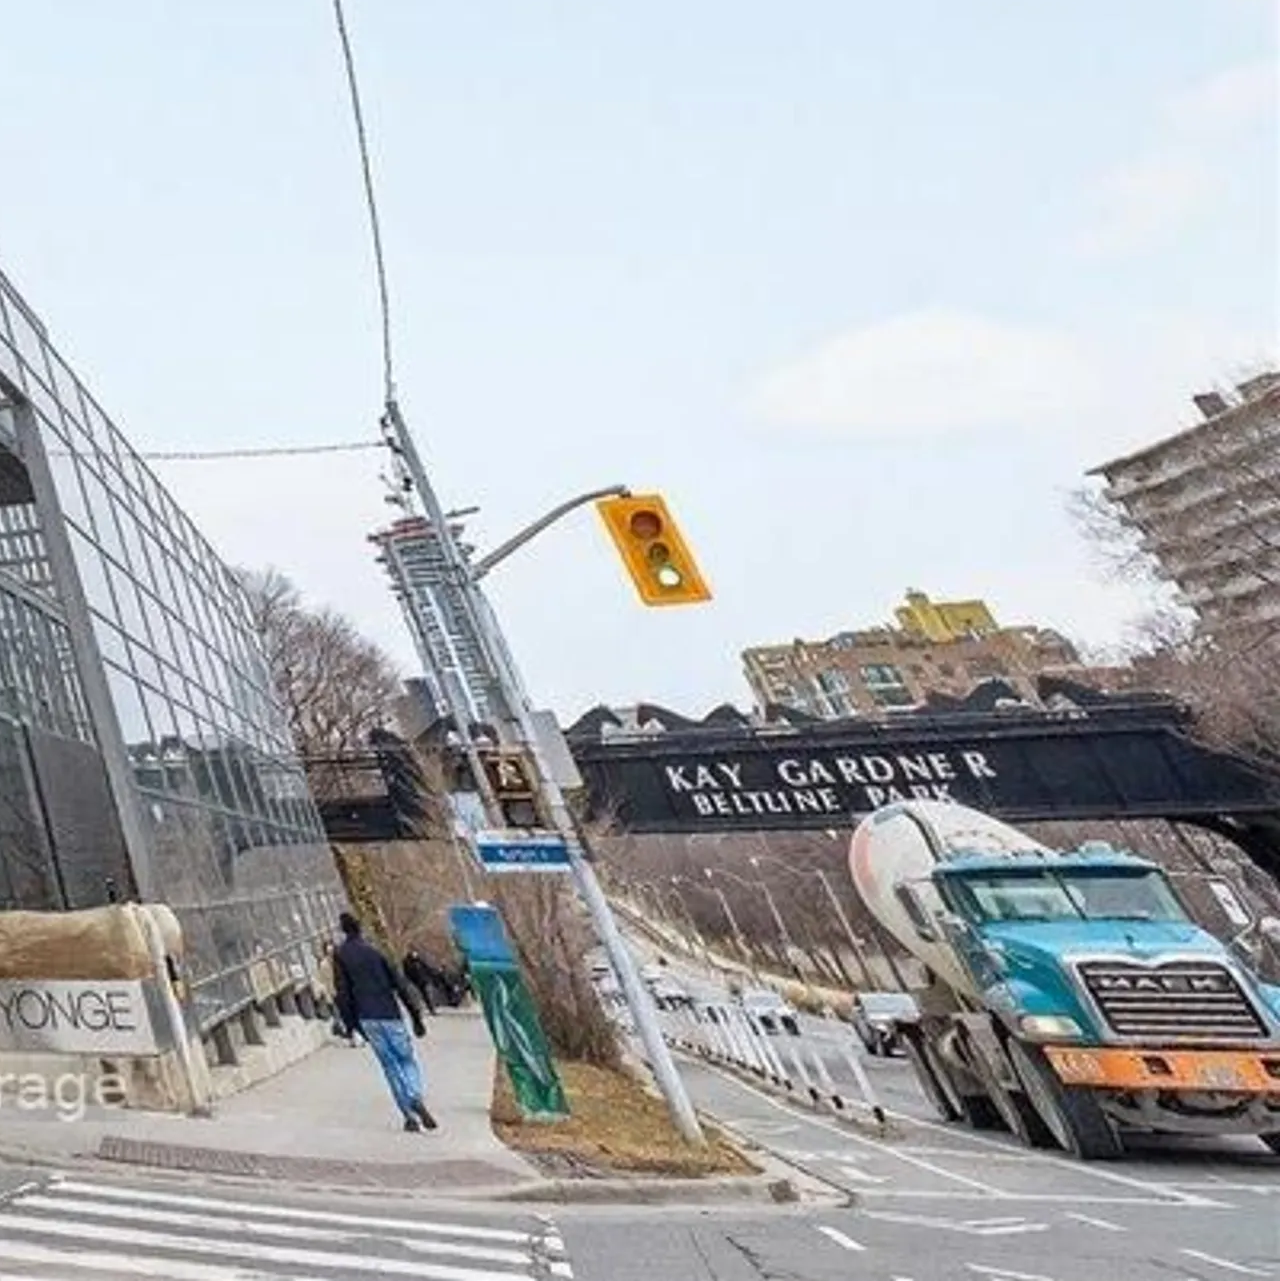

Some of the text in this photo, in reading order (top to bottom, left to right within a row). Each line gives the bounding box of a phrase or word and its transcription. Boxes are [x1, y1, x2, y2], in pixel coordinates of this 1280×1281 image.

[666, 751, 997, 792] KAY GARDNER
[692, 788, 840, 816] BELTLINE
